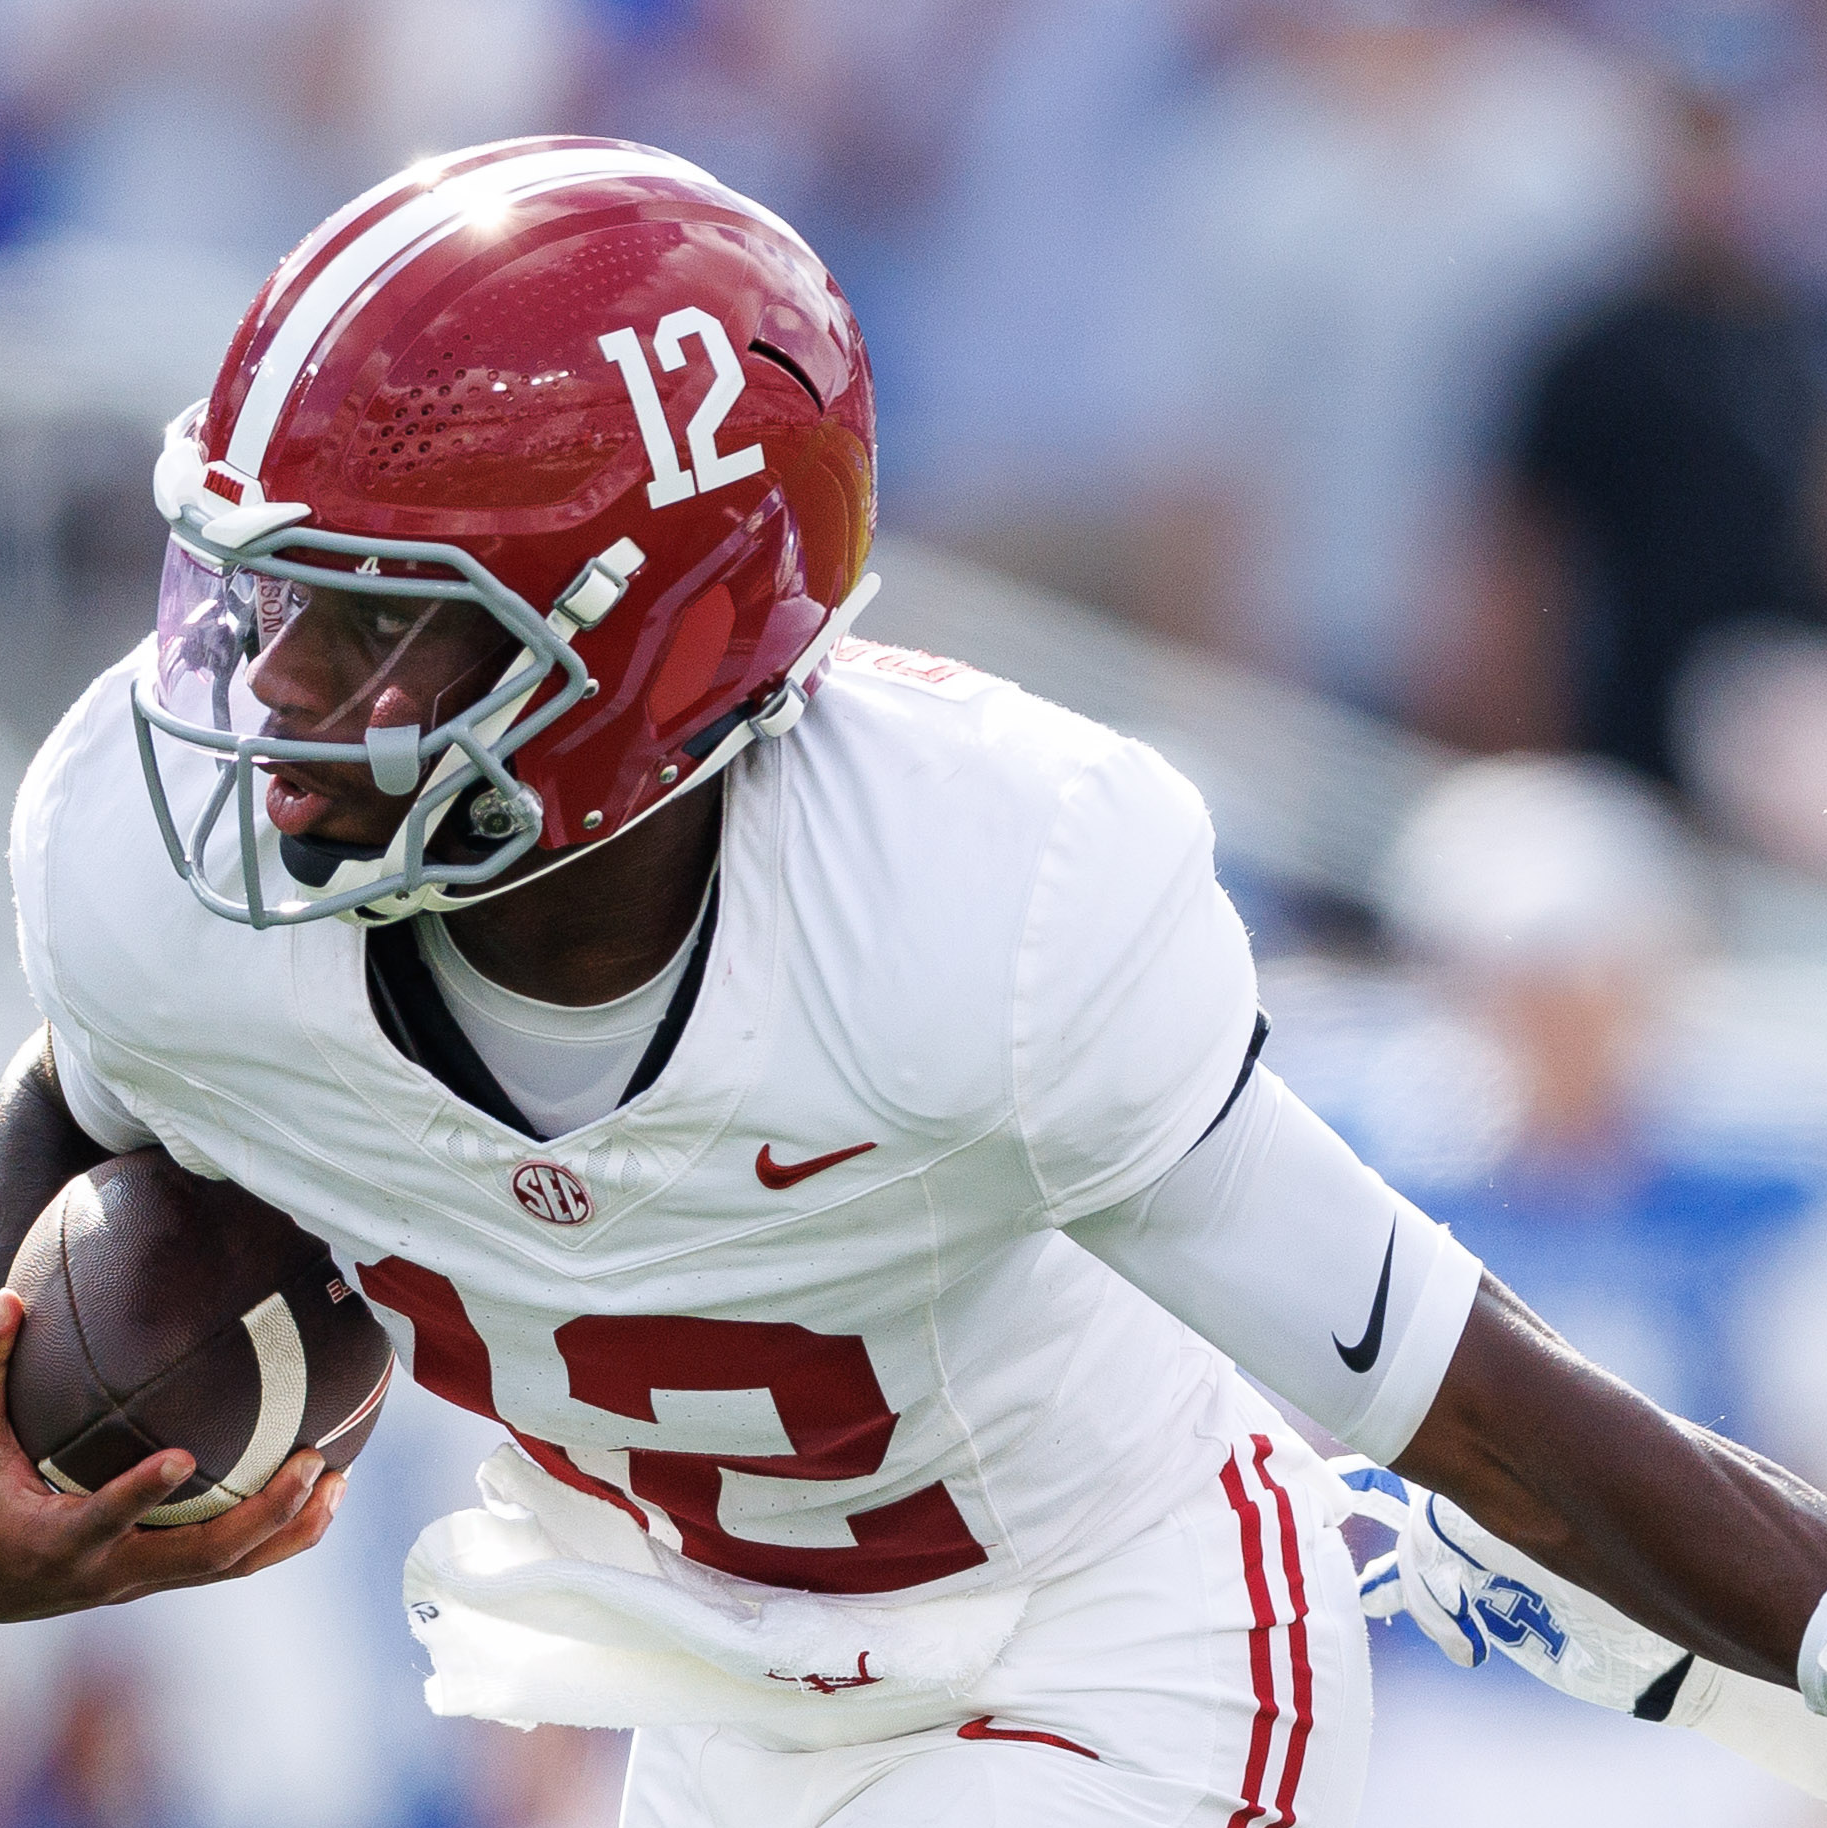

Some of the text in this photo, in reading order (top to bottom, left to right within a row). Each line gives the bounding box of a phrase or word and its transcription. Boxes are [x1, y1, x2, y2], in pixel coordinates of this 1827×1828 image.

[597, 305, 767, 510] 12
[515, 1165, 590, 1222] SEC
[354, 1253, 989, 1595] 12
